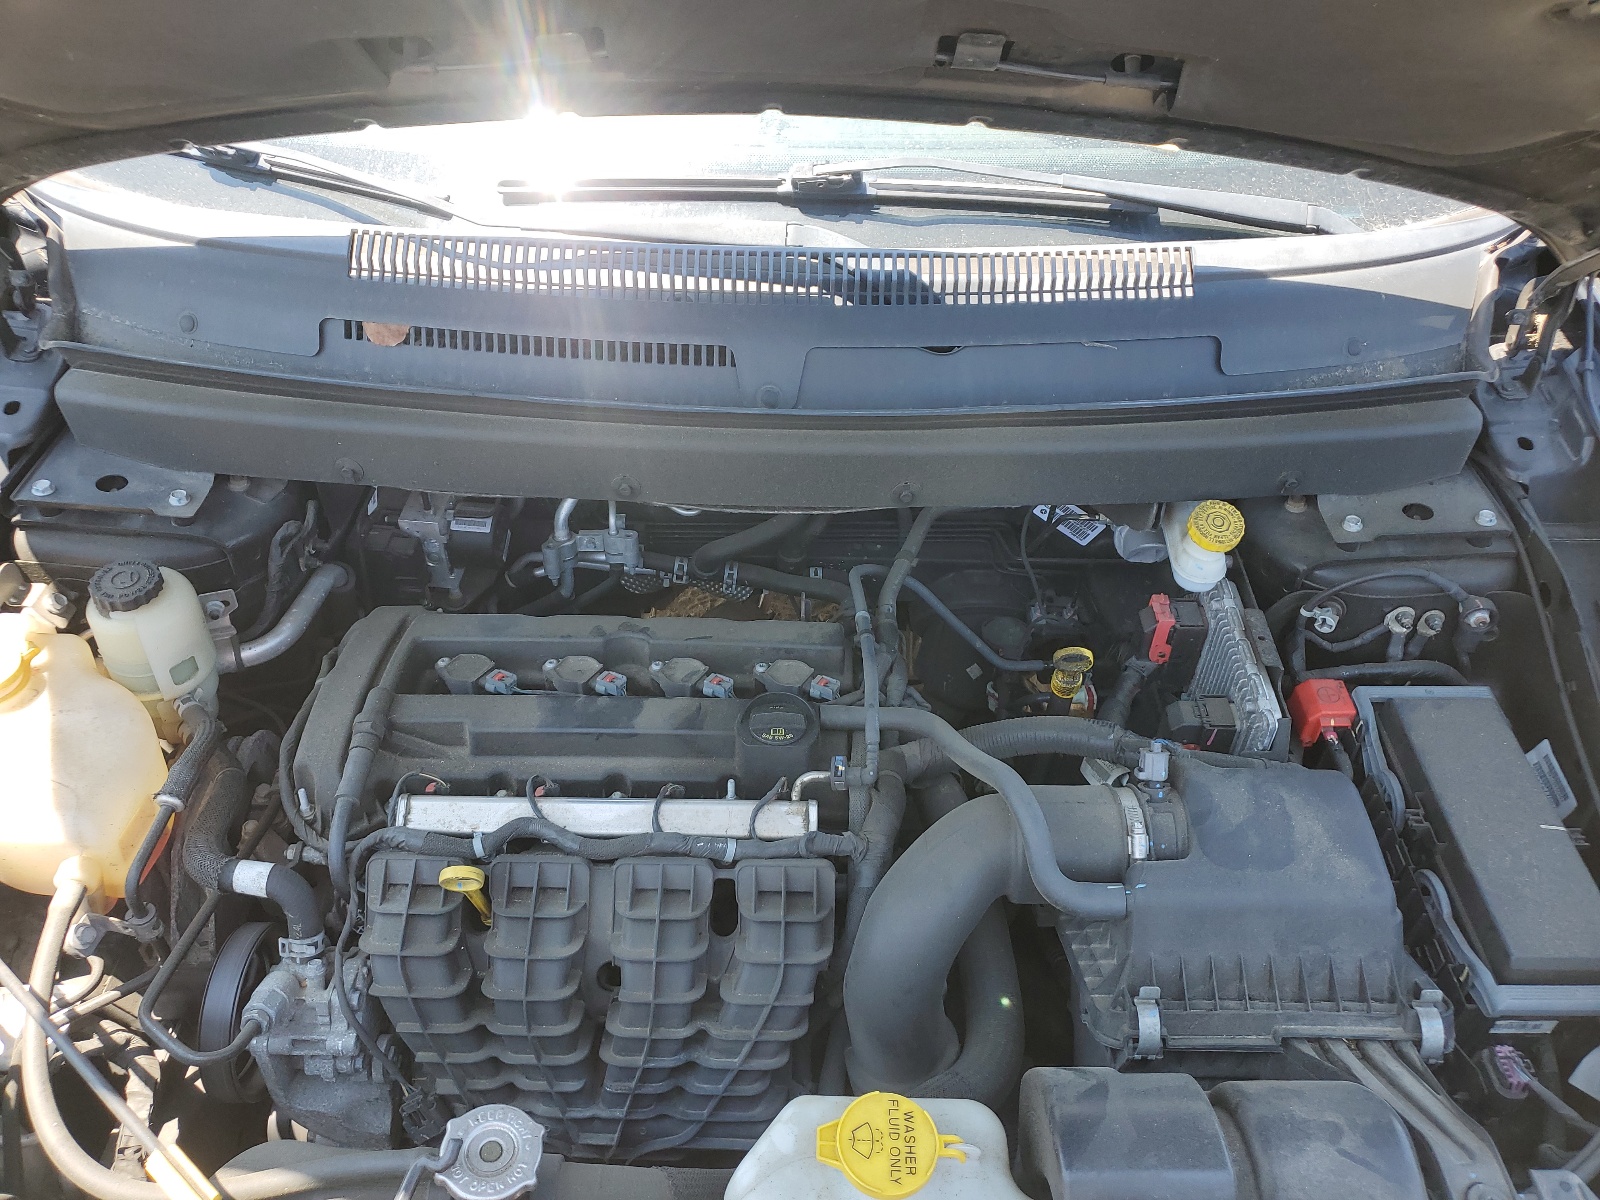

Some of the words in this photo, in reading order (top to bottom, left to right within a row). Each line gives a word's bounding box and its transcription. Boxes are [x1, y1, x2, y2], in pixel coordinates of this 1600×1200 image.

[888, 1100, 900, 1141] FLUID
[903, 1111, 917, 1176] WASHER
[889, 1146, 903, 1186] ONLY
